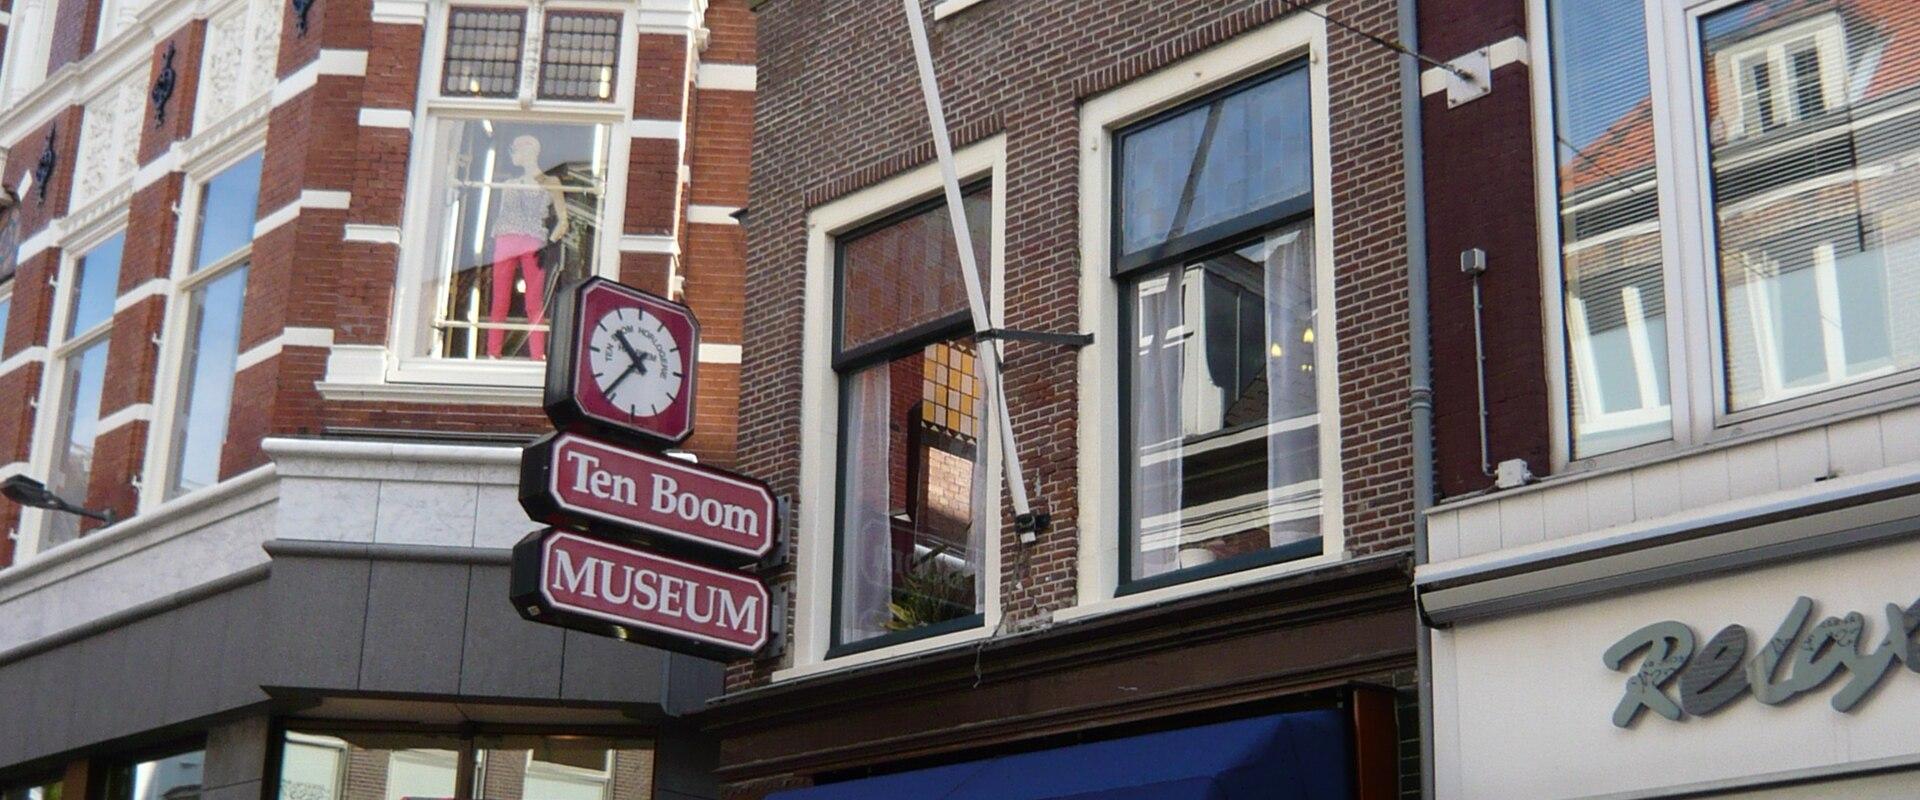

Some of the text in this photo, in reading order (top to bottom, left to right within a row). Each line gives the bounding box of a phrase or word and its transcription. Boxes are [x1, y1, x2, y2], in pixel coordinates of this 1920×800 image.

[605, 343, 614, 362] TEN
[611, 325, 634, 341] BOM
[567, 450, 759, 536] Ten Boom
[553, 549, 758, 634] MUSEUM
